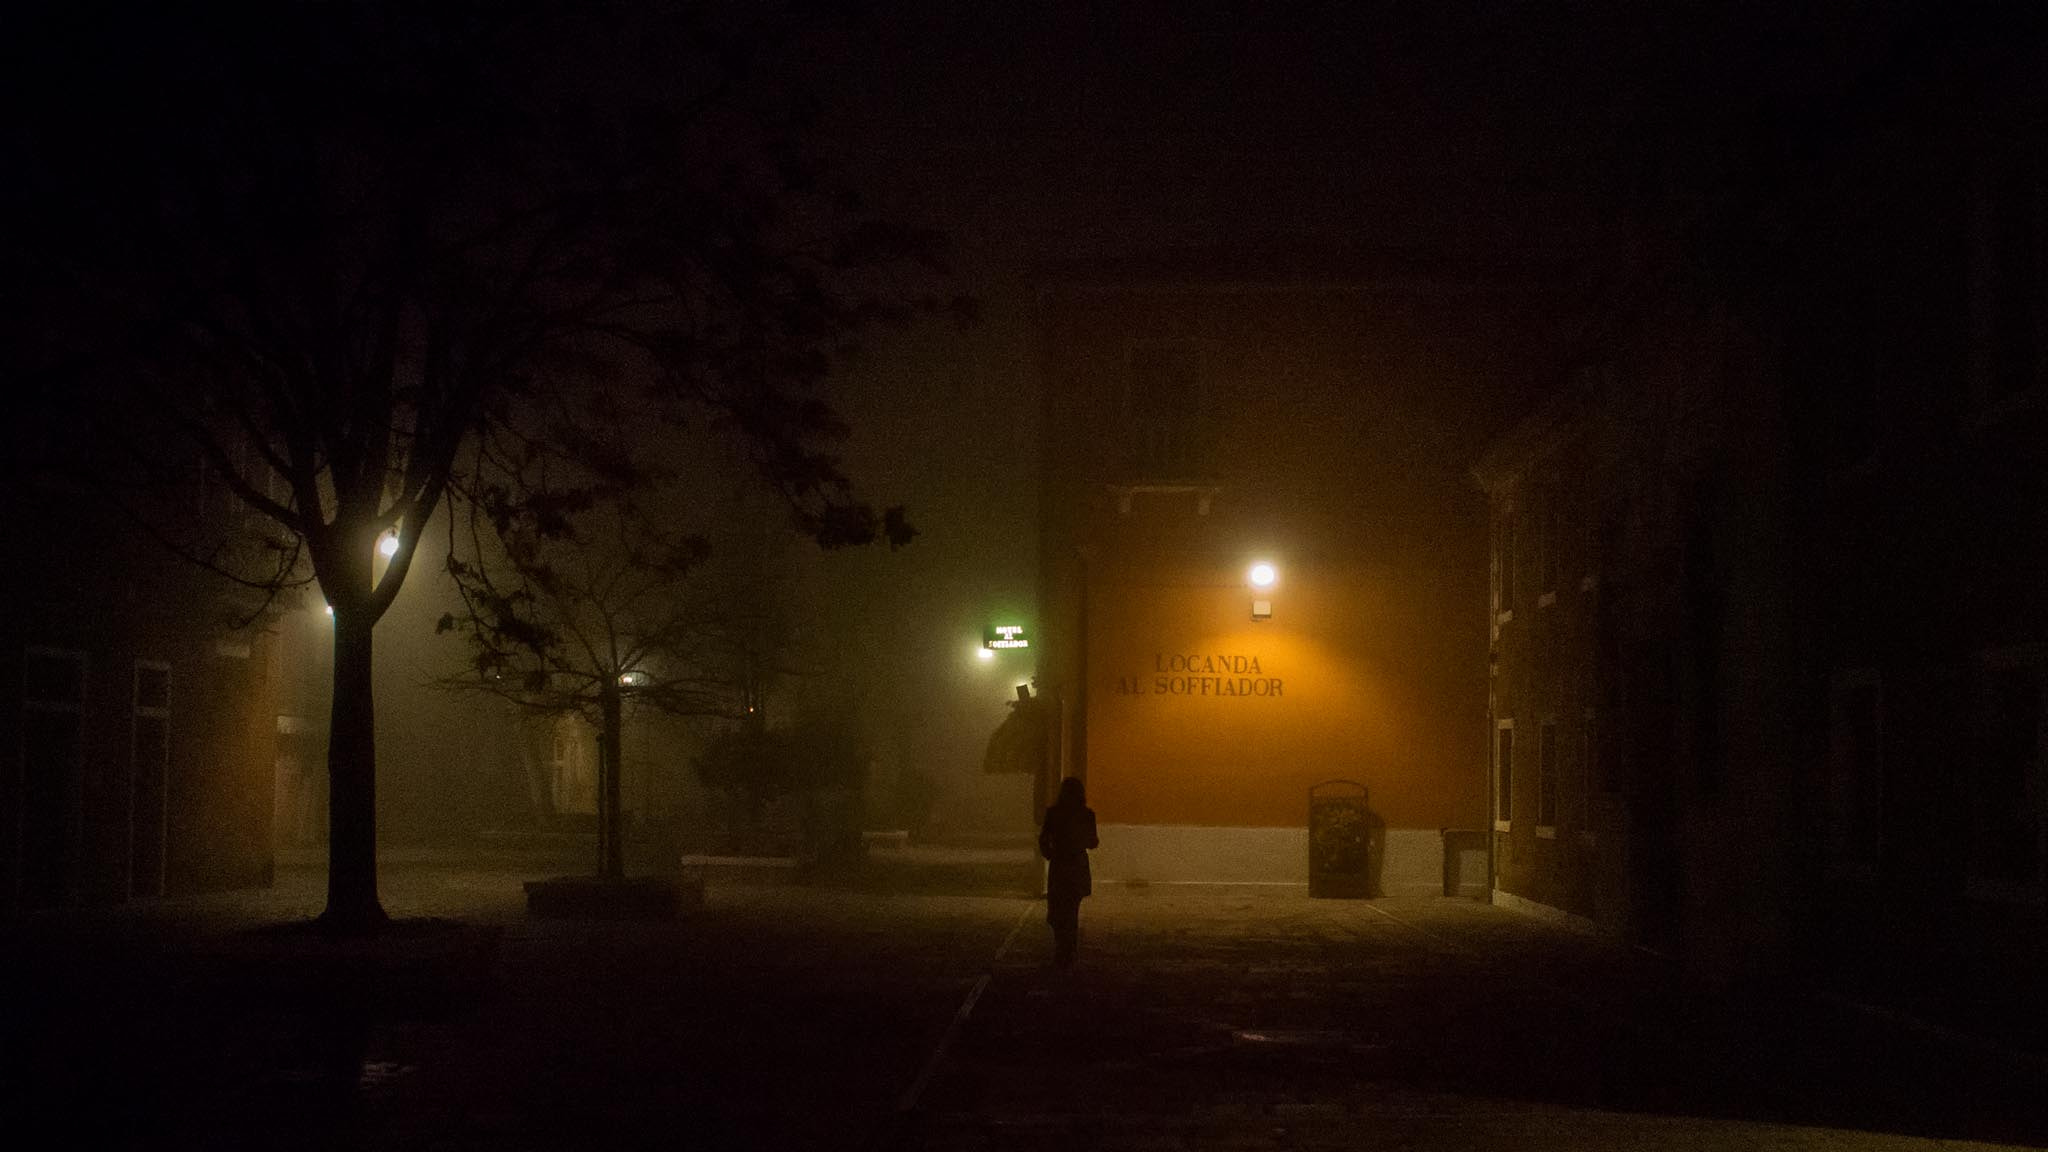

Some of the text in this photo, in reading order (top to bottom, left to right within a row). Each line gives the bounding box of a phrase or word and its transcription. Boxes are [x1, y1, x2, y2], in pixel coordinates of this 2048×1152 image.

[1155, 654, 1262, 674] LOCANDA
[1112, 677, 1284, 697] AL SOFFIADOR
